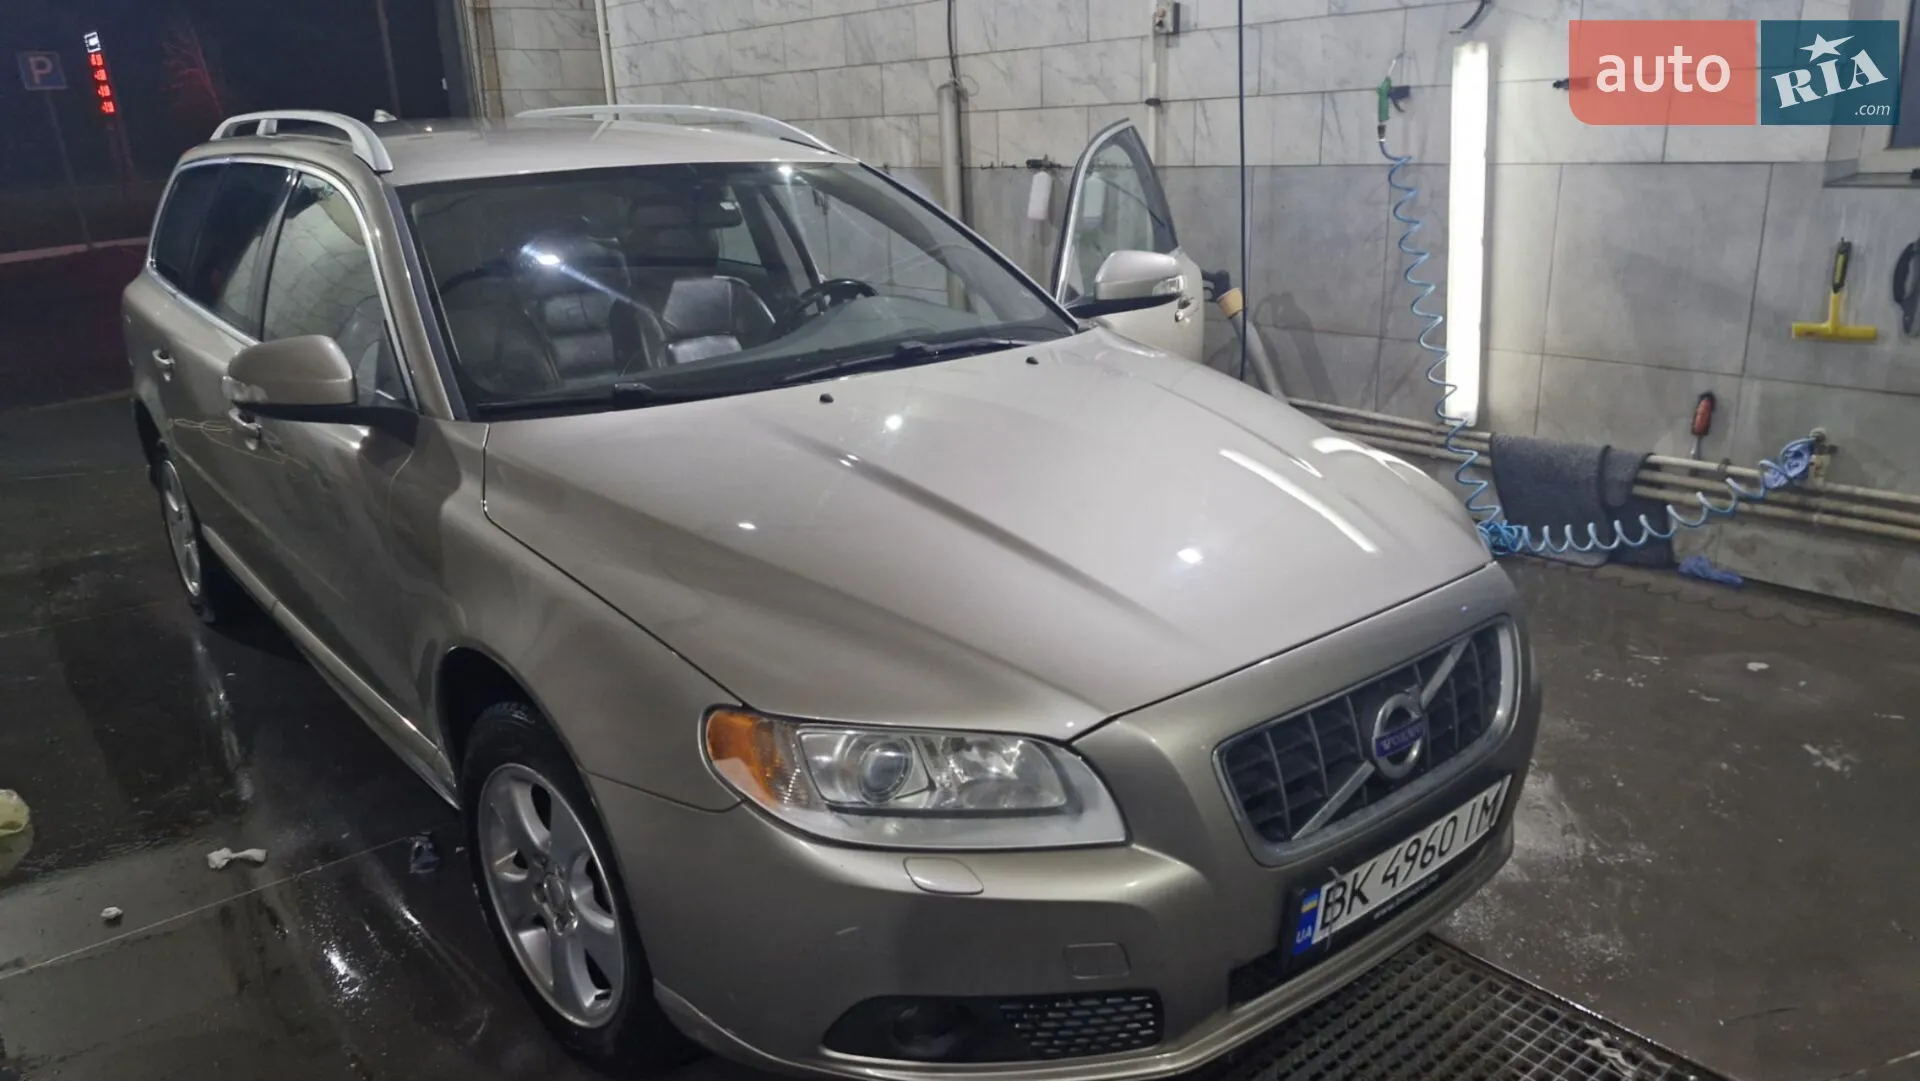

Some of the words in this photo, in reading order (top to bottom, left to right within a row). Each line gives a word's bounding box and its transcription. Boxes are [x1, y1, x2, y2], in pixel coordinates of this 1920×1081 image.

[29, 55, 53, 84] P
[1379, 722, 1424, 751] VOLVO
[1320, 861, 1377, 931] BK
[1381, 815, 1458, 889] 4960
[1464, 785, 1502, 843] IM
[1296, 926, 1312, 944] UA
